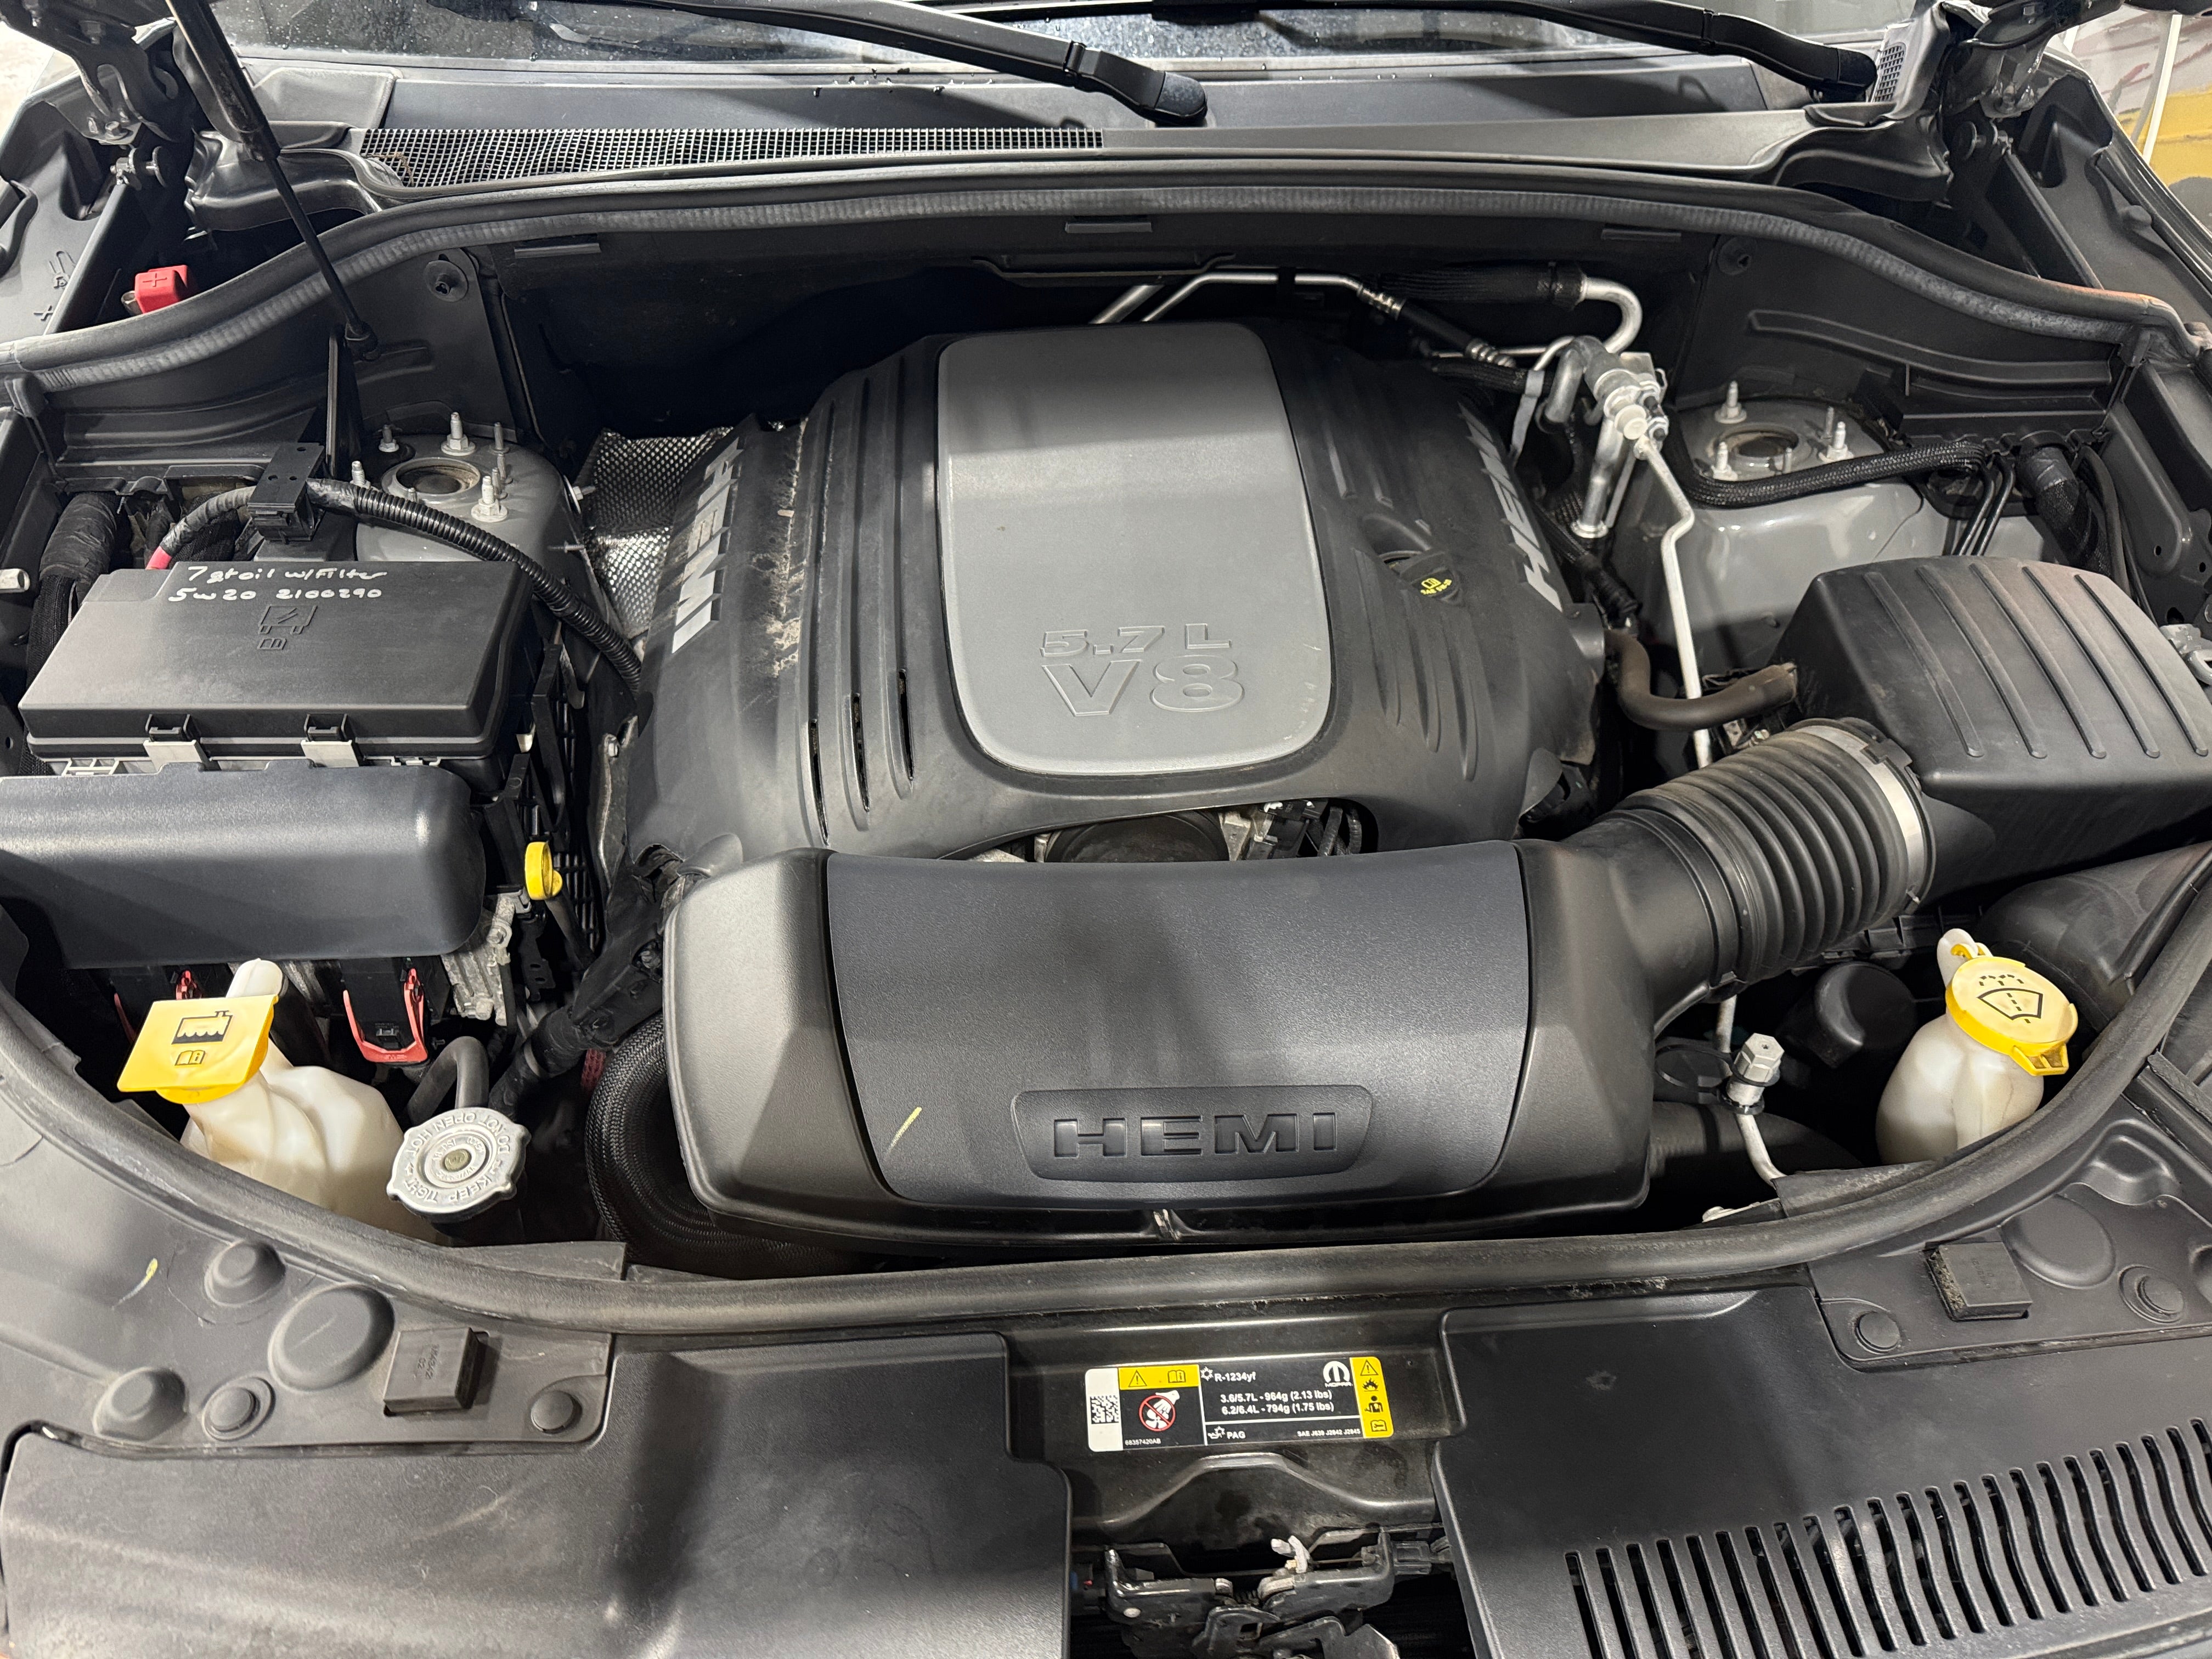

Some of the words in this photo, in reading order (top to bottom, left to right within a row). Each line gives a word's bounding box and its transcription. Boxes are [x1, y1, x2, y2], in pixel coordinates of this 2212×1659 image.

[188, 566, 208, 581] 7
[1041, 654, 1245, 717] V8
[432, 1112, 477, 1132] OPEN
[406, 1130, 433, 1156] HOT
[1054, 1113, 1338, 1159] HEMI
[448, 1174, 492, 1203] KEEP
[1214, 1371, 1256, 1383] R-1234yf
[1220, 1392, 1259, 1403] 3.6/5.7L
[1265, 1391, 1289, 1402] 964g
[1290, 1390, 1313, 1402] (2.13
[1314, 1389, 1333, 1400] lbs)
[1221, 1404, 1260, 1415] 6.2/6.4L
[1266, 1403, 1290, 1414] 794g
[1291, 1402, 1315, 1414] (1.75
[1316, 1401, 1334, 1412] lbs)
[1227, 1431, 1246, 1440] PAG
